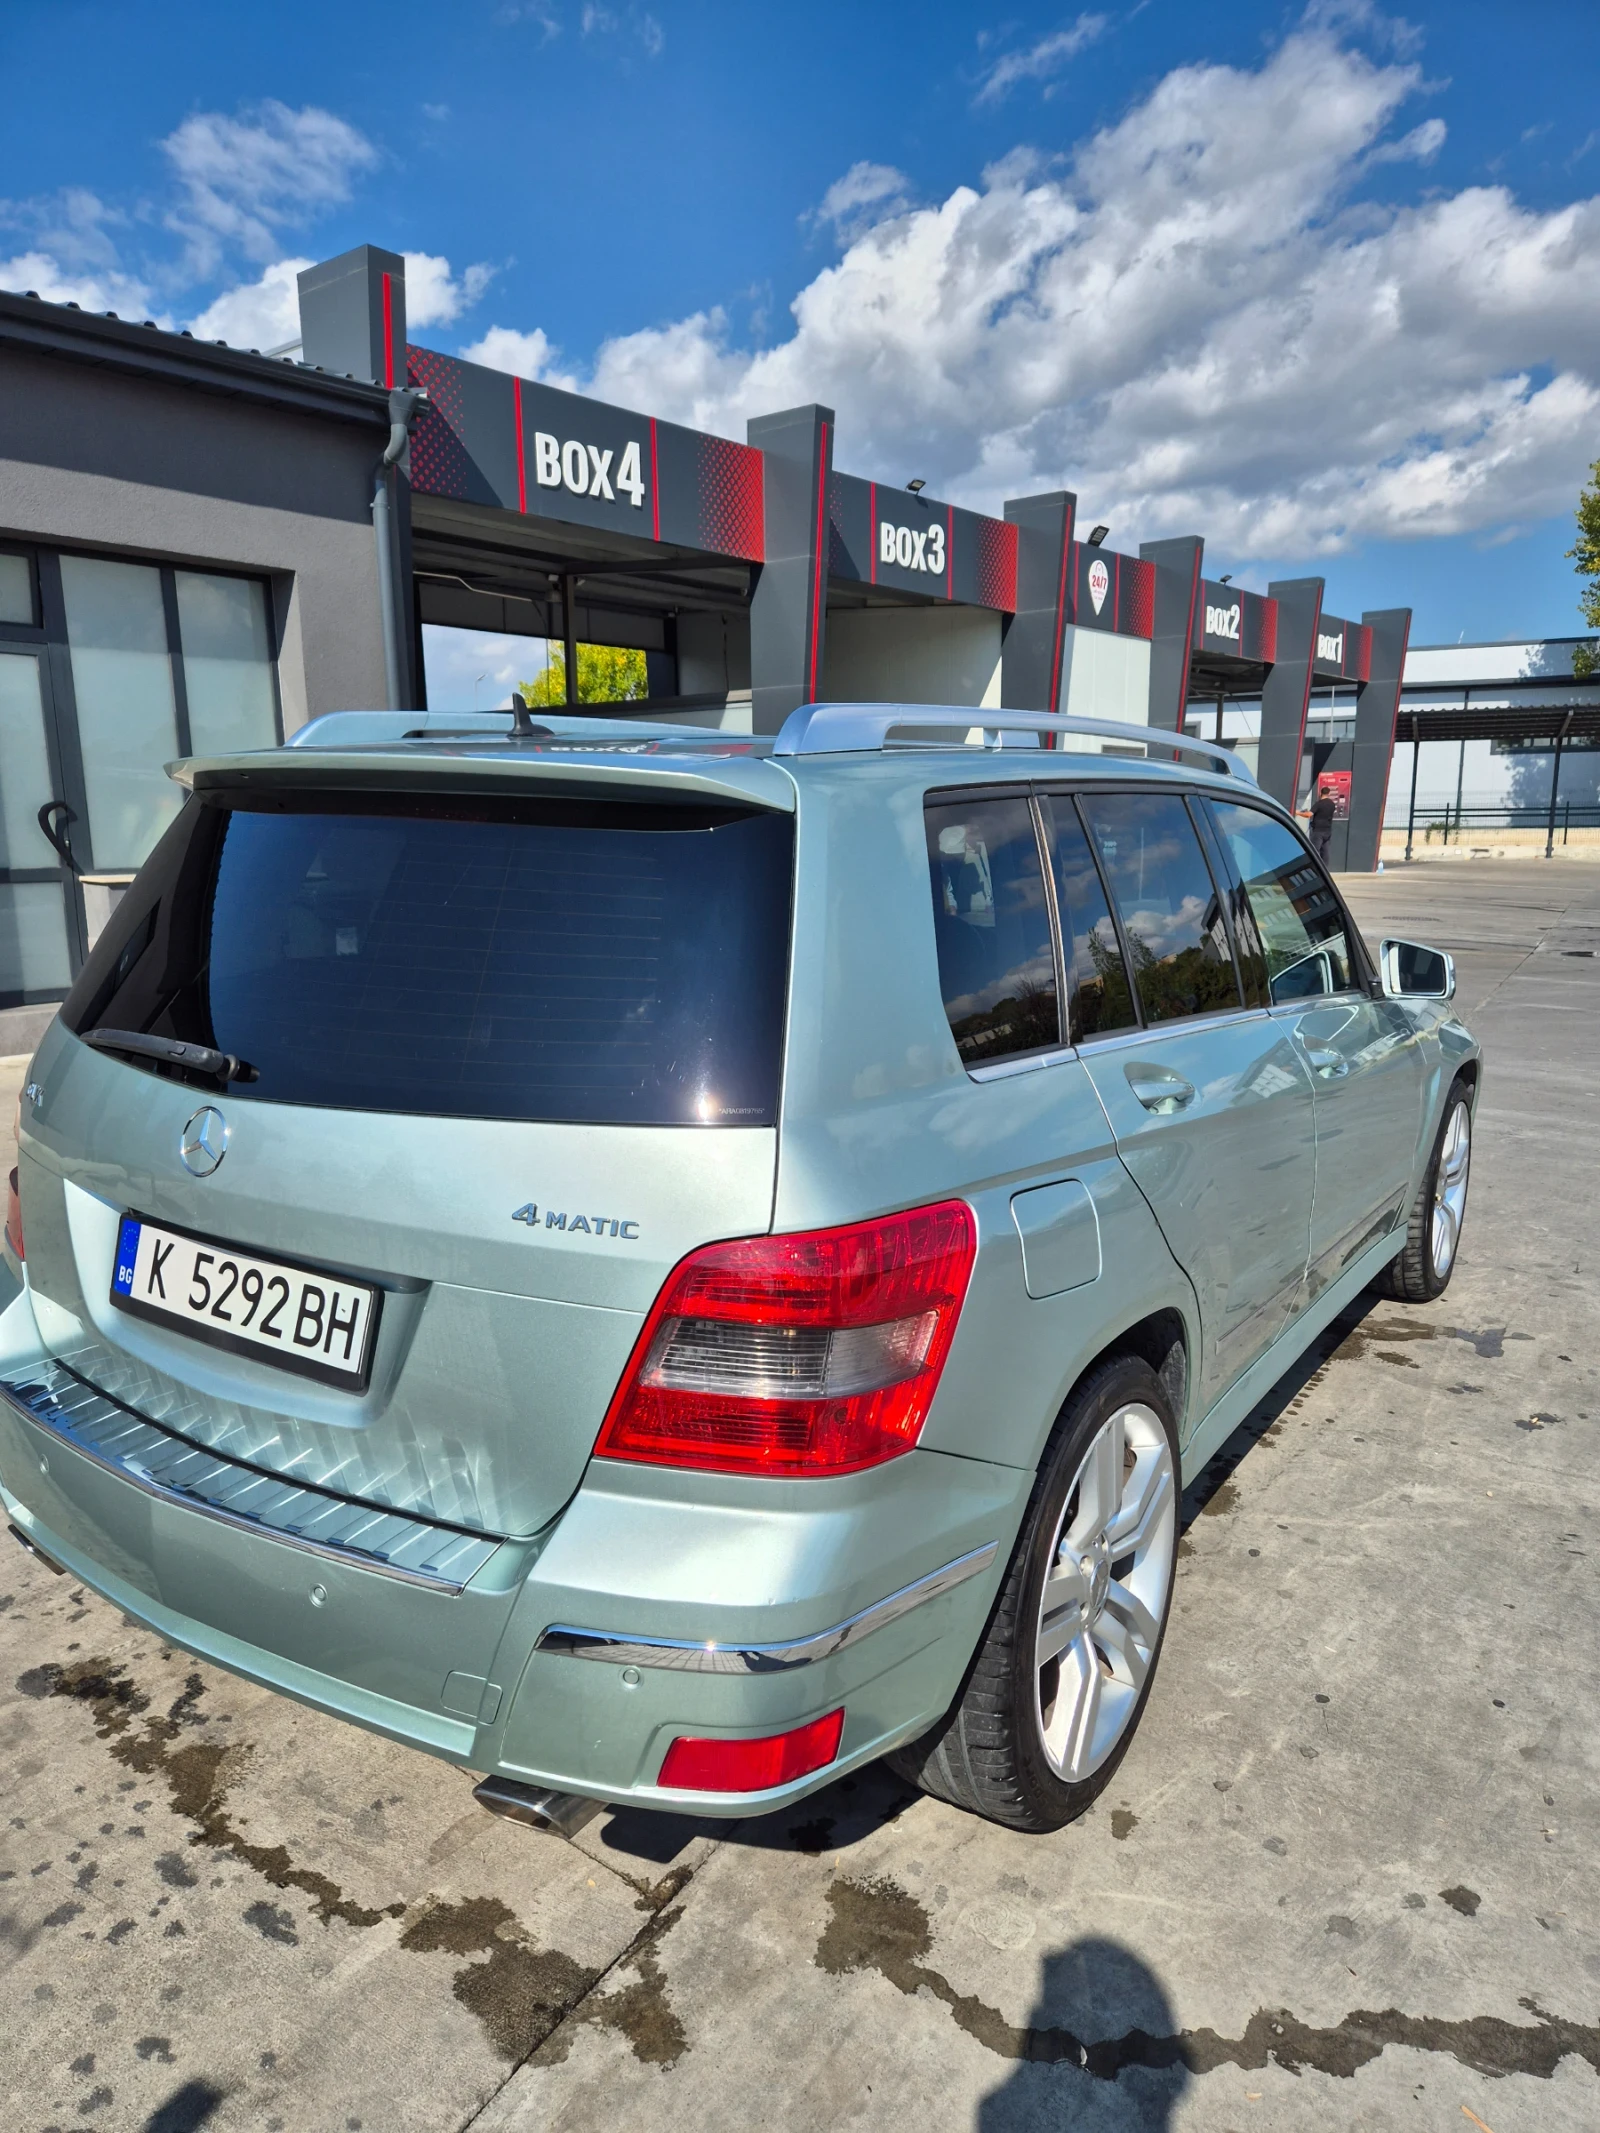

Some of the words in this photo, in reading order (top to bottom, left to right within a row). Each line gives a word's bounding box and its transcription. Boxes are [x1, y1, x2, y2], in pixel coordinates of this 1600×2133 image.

[880, 521, 946, 575] BOX3
[1091, 574, 1107, 590] 24/7
[1205, 603, 1241, 640] BOX2
[1317, 633, 1343, 664] BOX1
[118, 1265, 133, 1285] BG
[147, 1238, 175, 1300] K
